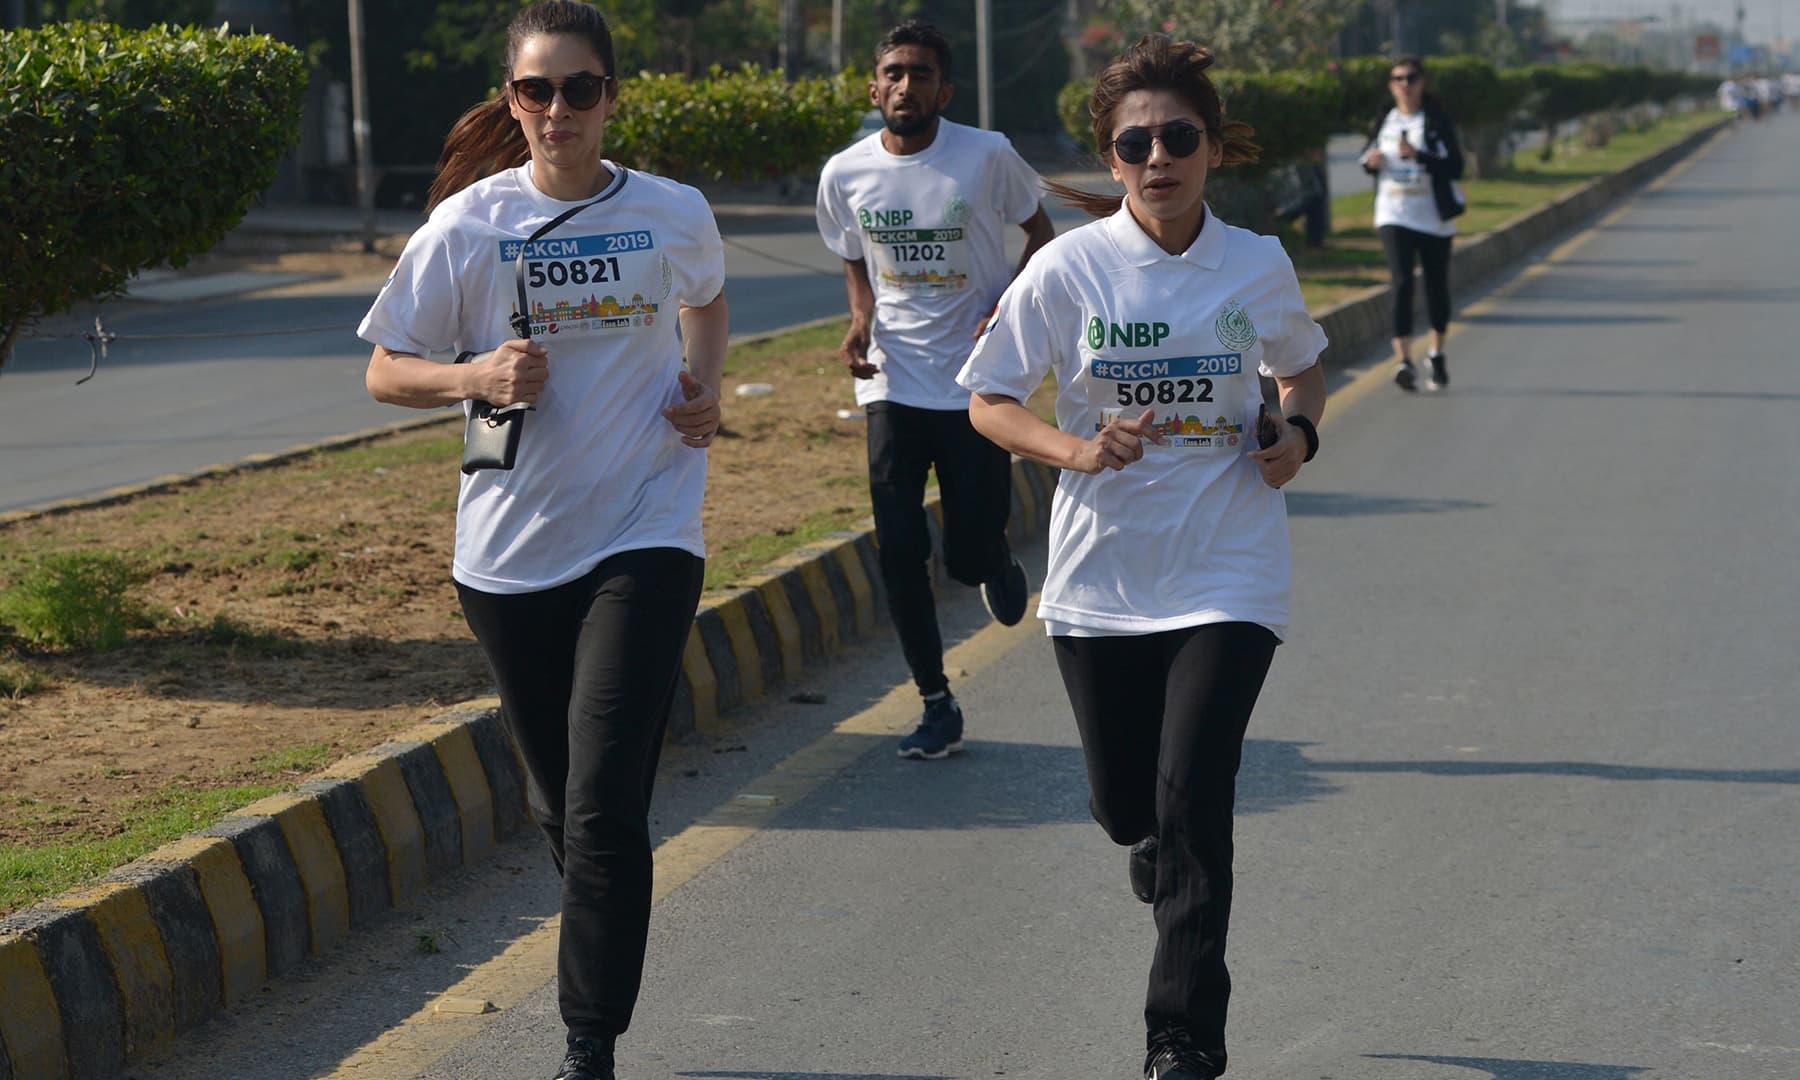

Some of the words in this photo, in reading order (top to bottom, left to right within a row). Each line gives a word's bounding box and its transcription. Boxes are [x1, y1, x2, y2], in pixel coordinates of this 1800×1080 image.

[875, 210, 912, 226] NBP
[505, 240, 579, 259] #CKCM
[606, 233, 650, 251] 2019
[933, 230, 960, 241] 2019
[892, 244, 945, 261] 11202
[528, 257, 621, 288] 50821
[1110, 322, 1170, 348] NBP
[1096, 361, 1169, 378] #CKCM
[1197, 356, 1239, 374] 2019
[1117, 378, 1214, 406] 50822
